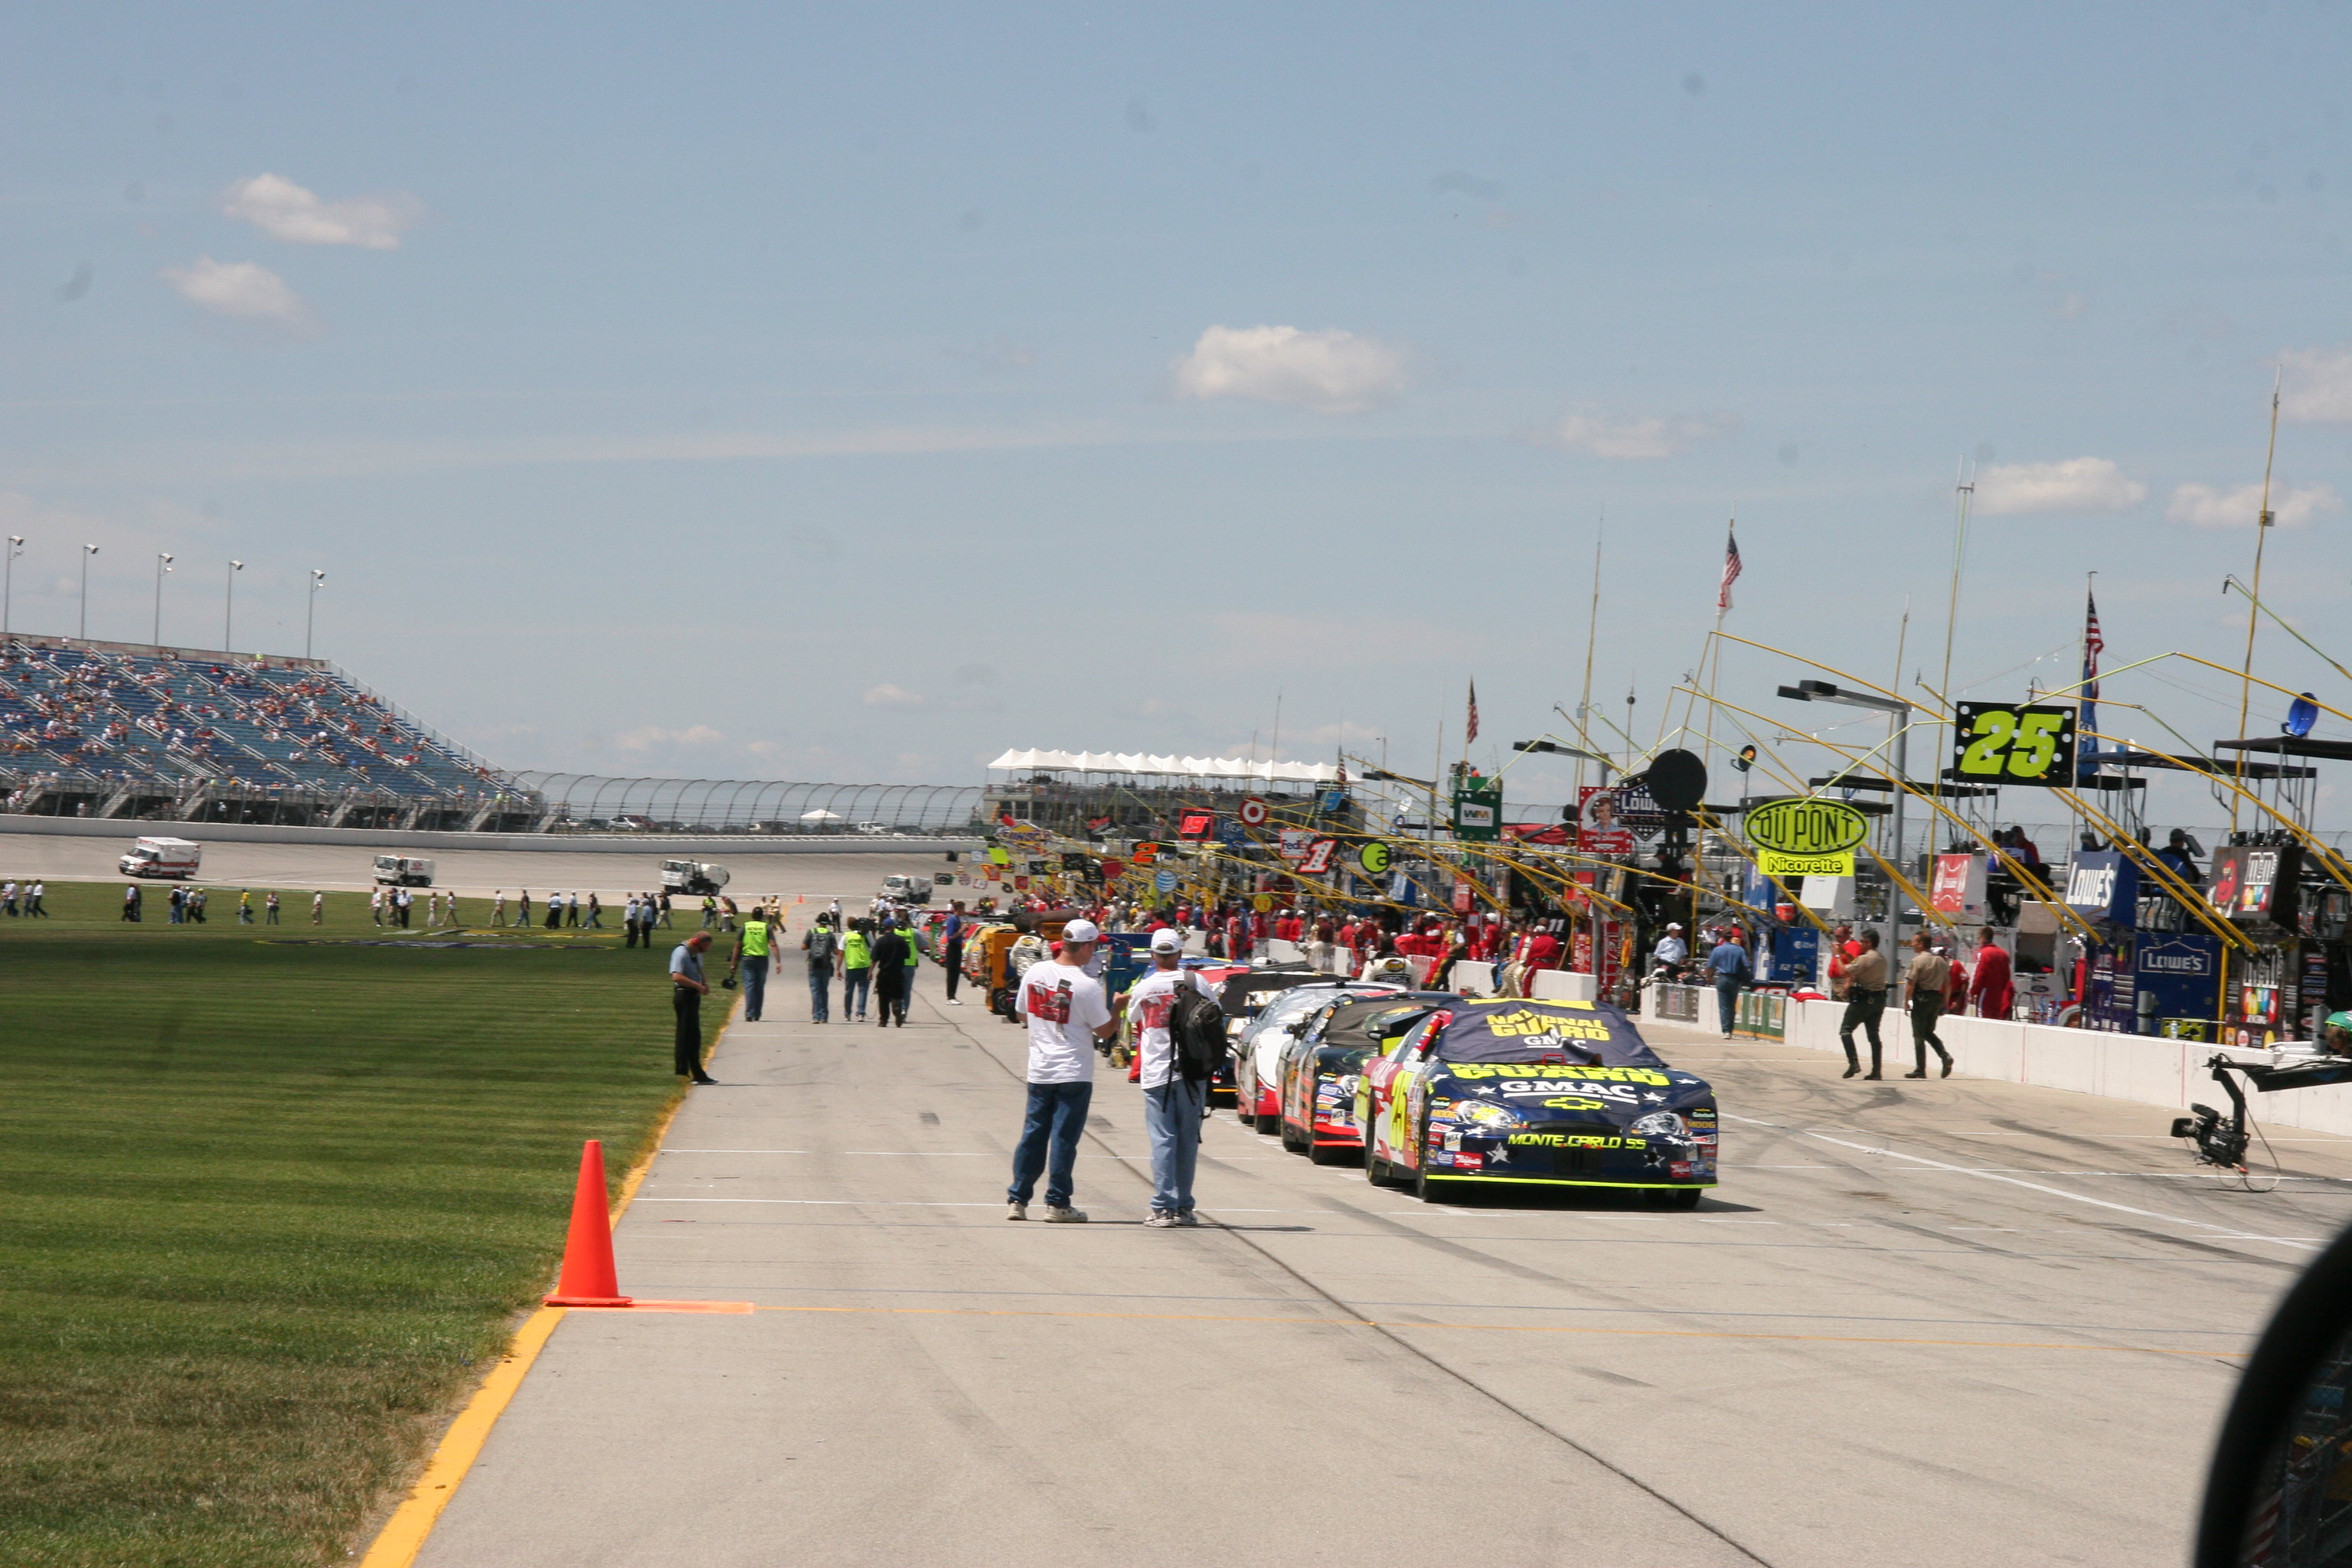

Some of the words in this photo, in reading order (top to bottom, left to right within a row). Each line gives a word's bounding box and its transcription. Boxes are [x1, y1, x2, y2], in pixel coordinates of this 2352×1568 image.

[1959, 710, 2064, 777] 25
[1760, 811, 1786, 844] DU
[1794, 809, 1853, 847] PONT
[1132, 843, 1158, 863] 2
[1298, 840, 1337, 873] 1
[1769, 856, 1843, 874] Nicorette
[1452, 1068, 1671, 1086] GUARD
[1499, 1080, 1638, 1098] GMAC
[1508, 1134, 1566, 1148] MONTE
[1567, 1135, 1622, 1149] CARLO
[1624, 1138, 1647, 1150] SS
